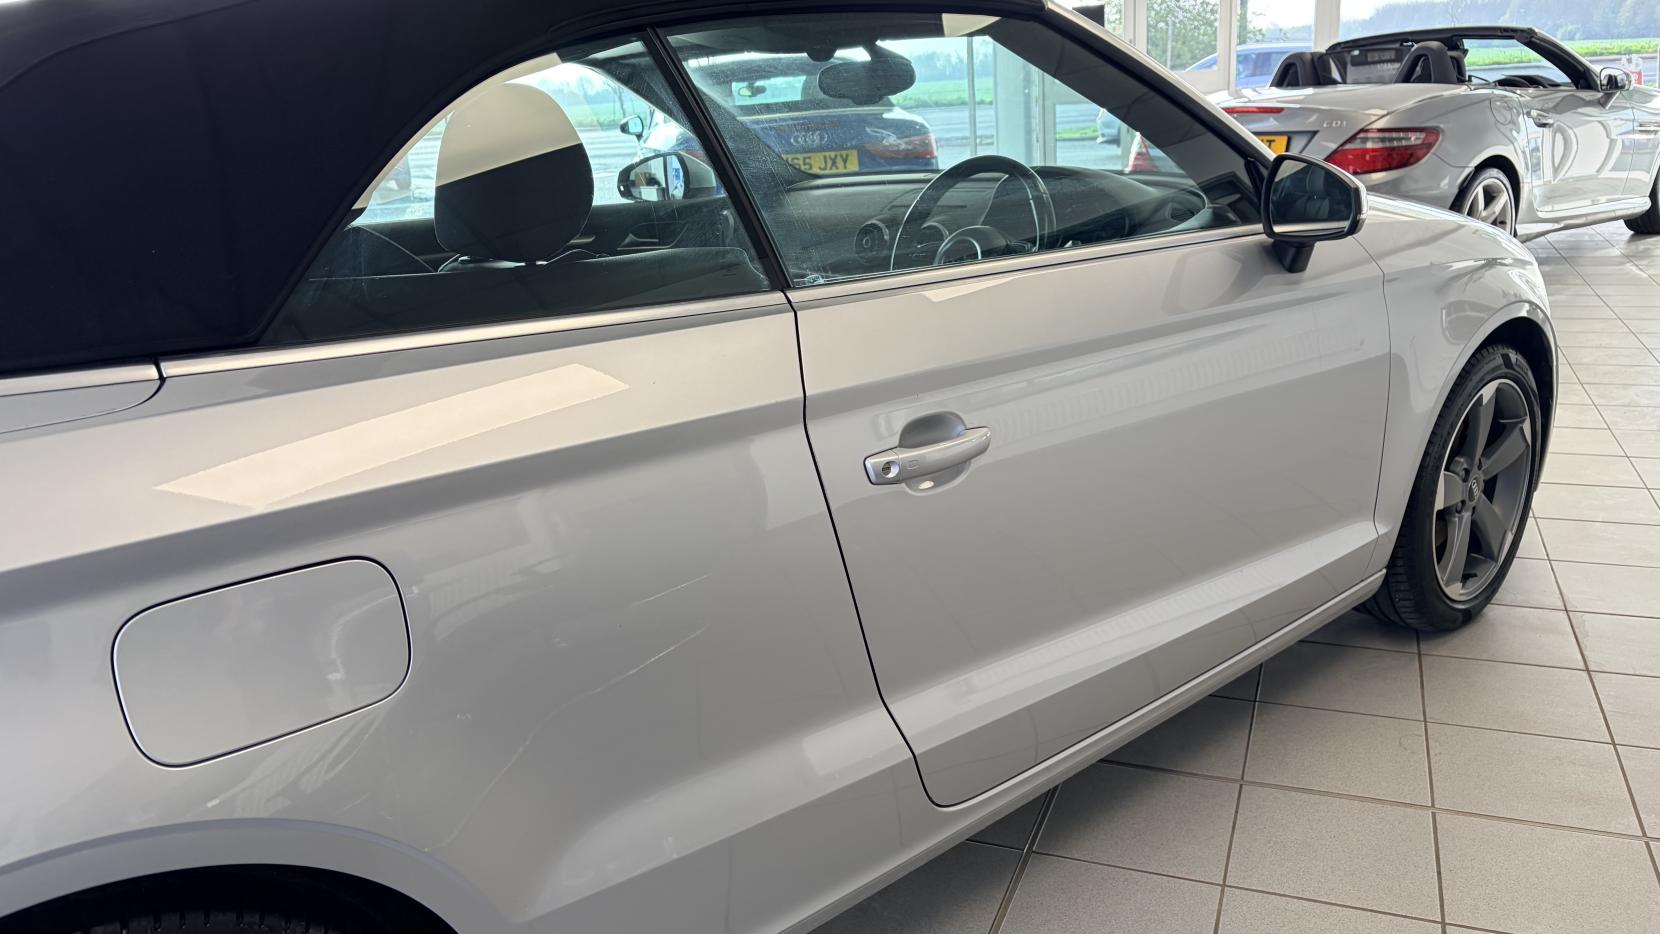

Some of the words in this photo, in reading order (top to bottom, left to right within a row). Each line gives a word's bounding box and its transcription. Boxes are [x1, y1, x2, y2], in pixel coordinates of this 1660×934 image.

[1323, 120, 1347, 128] CDI
[785, 156, 813, 170] 65
[819, 153, 849, 170] JXY
